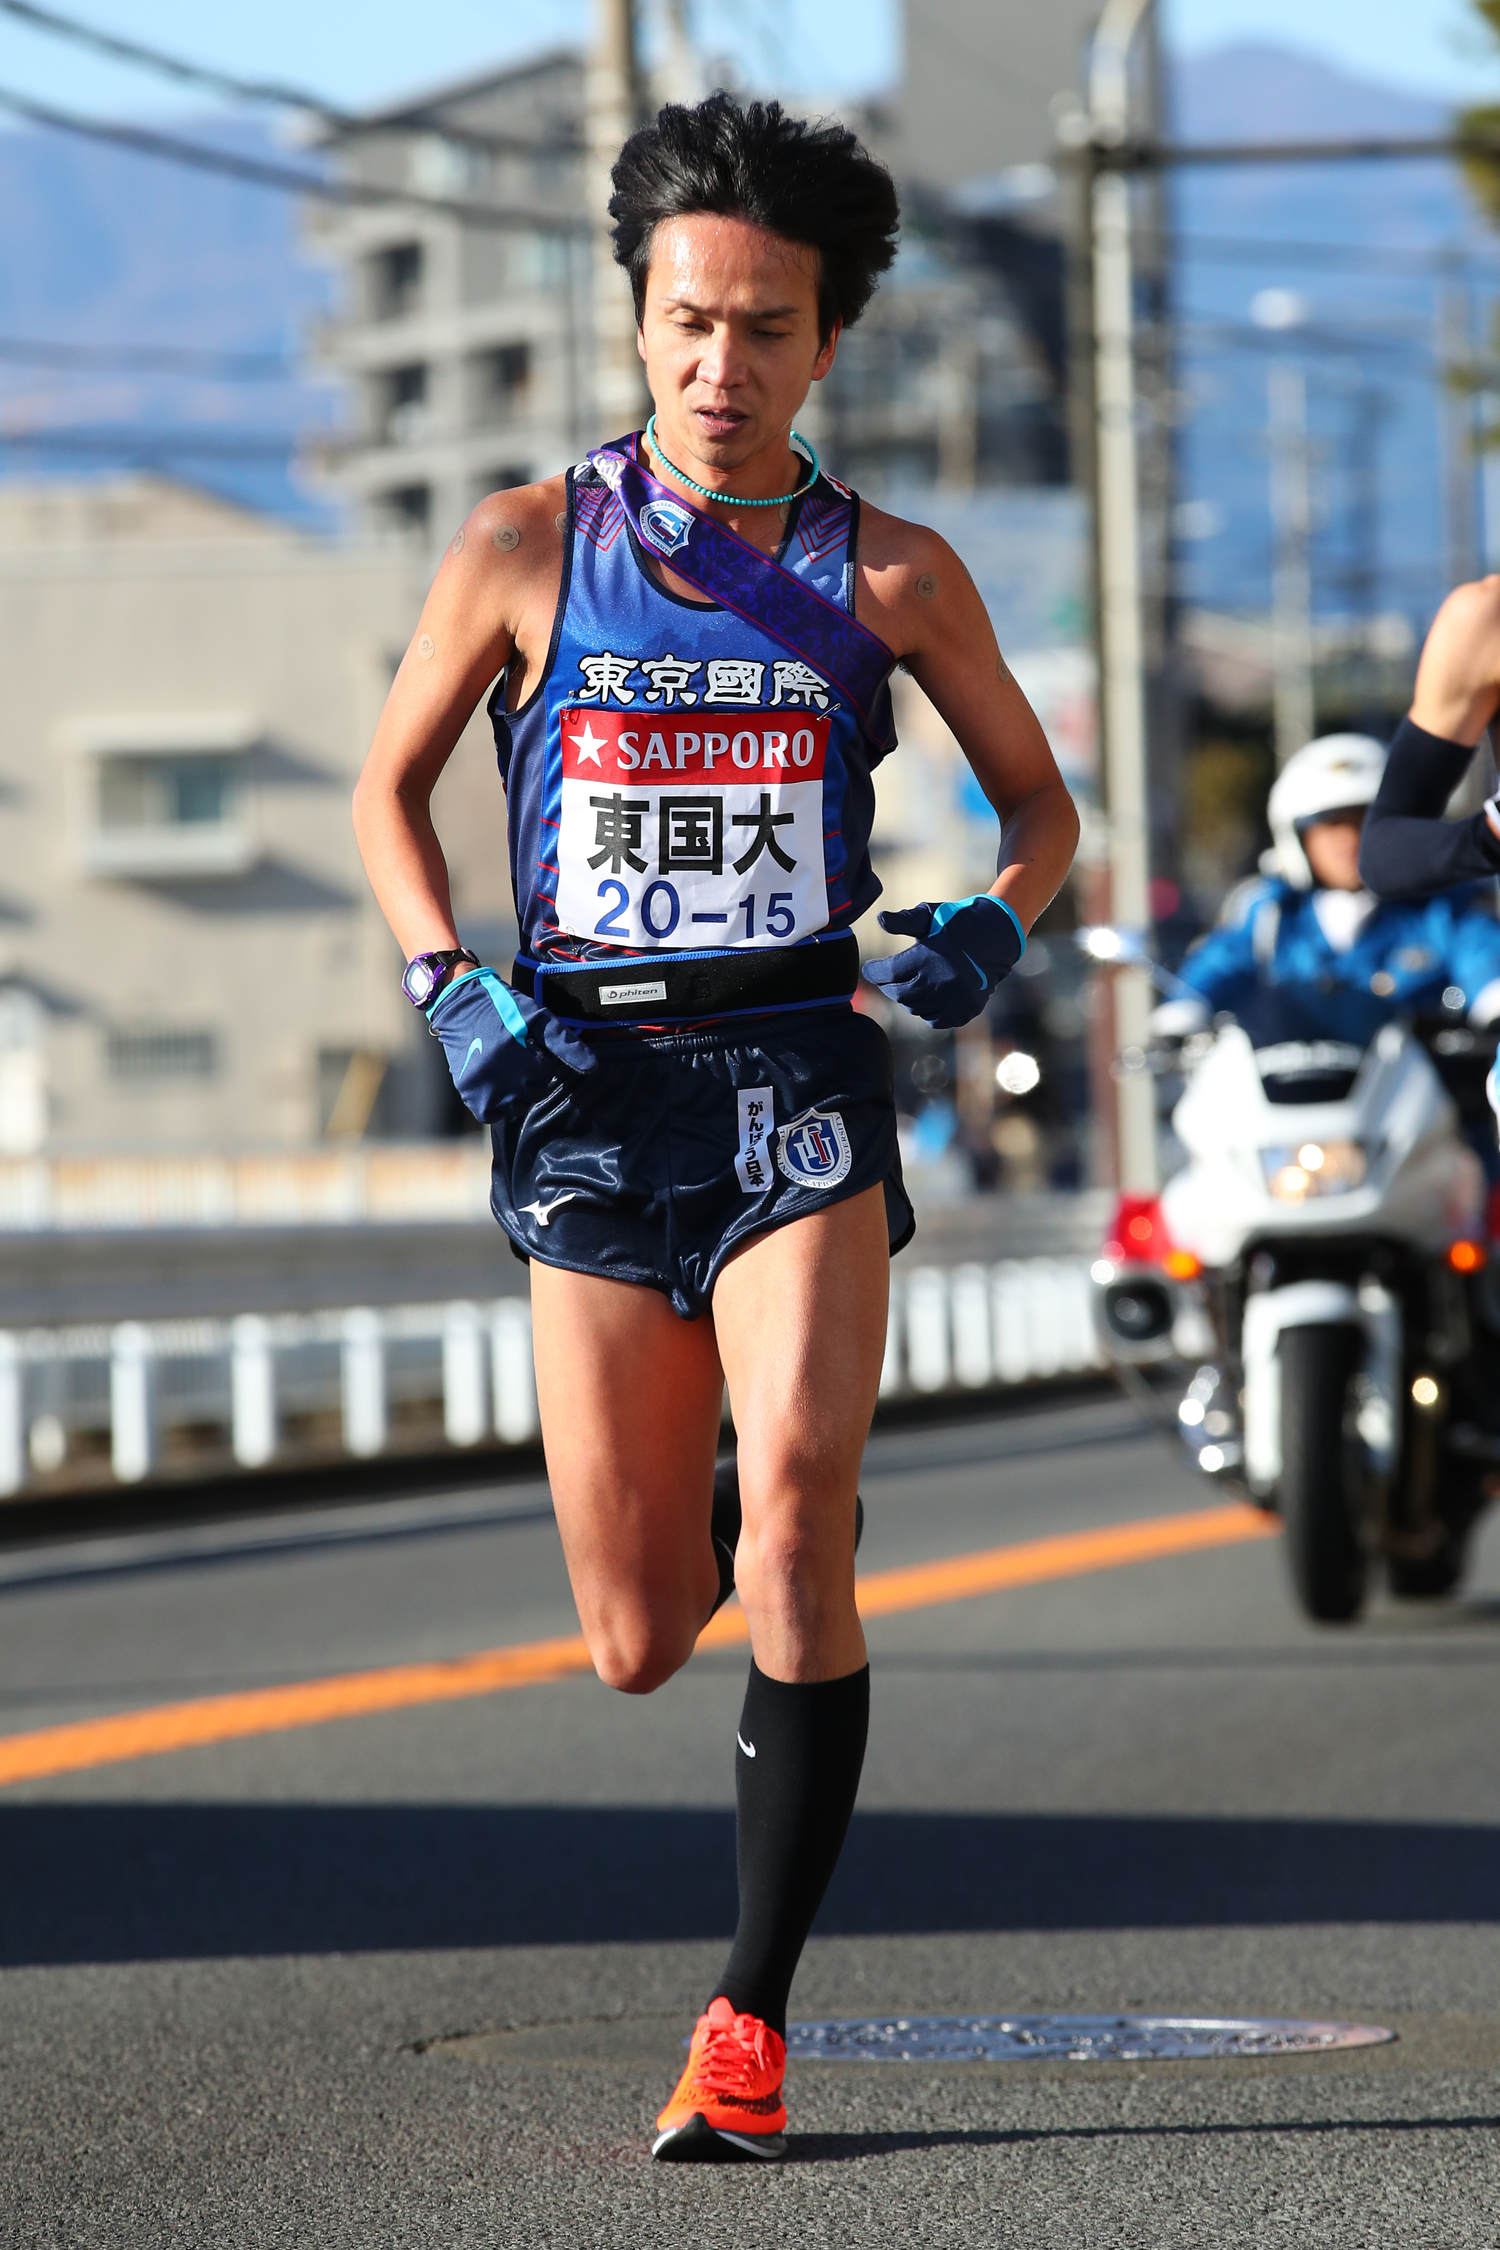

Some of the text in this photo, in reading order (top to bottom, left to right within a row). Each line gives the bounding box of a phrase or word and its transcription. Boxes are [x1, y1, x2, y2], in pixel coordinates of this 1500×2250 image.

[578, 652, 830, 708] 東京國際
[617, 729, 815, 770] SAPPORO
[587, 793, 797, 875] 東国大
[594, 879, 796, 939] 20-15
[619, 988, 658, 999] phiten
[744, 1101, 765, 1187] がんばう日本
[835, 1115, 851, 1171] UNIVERSITY
